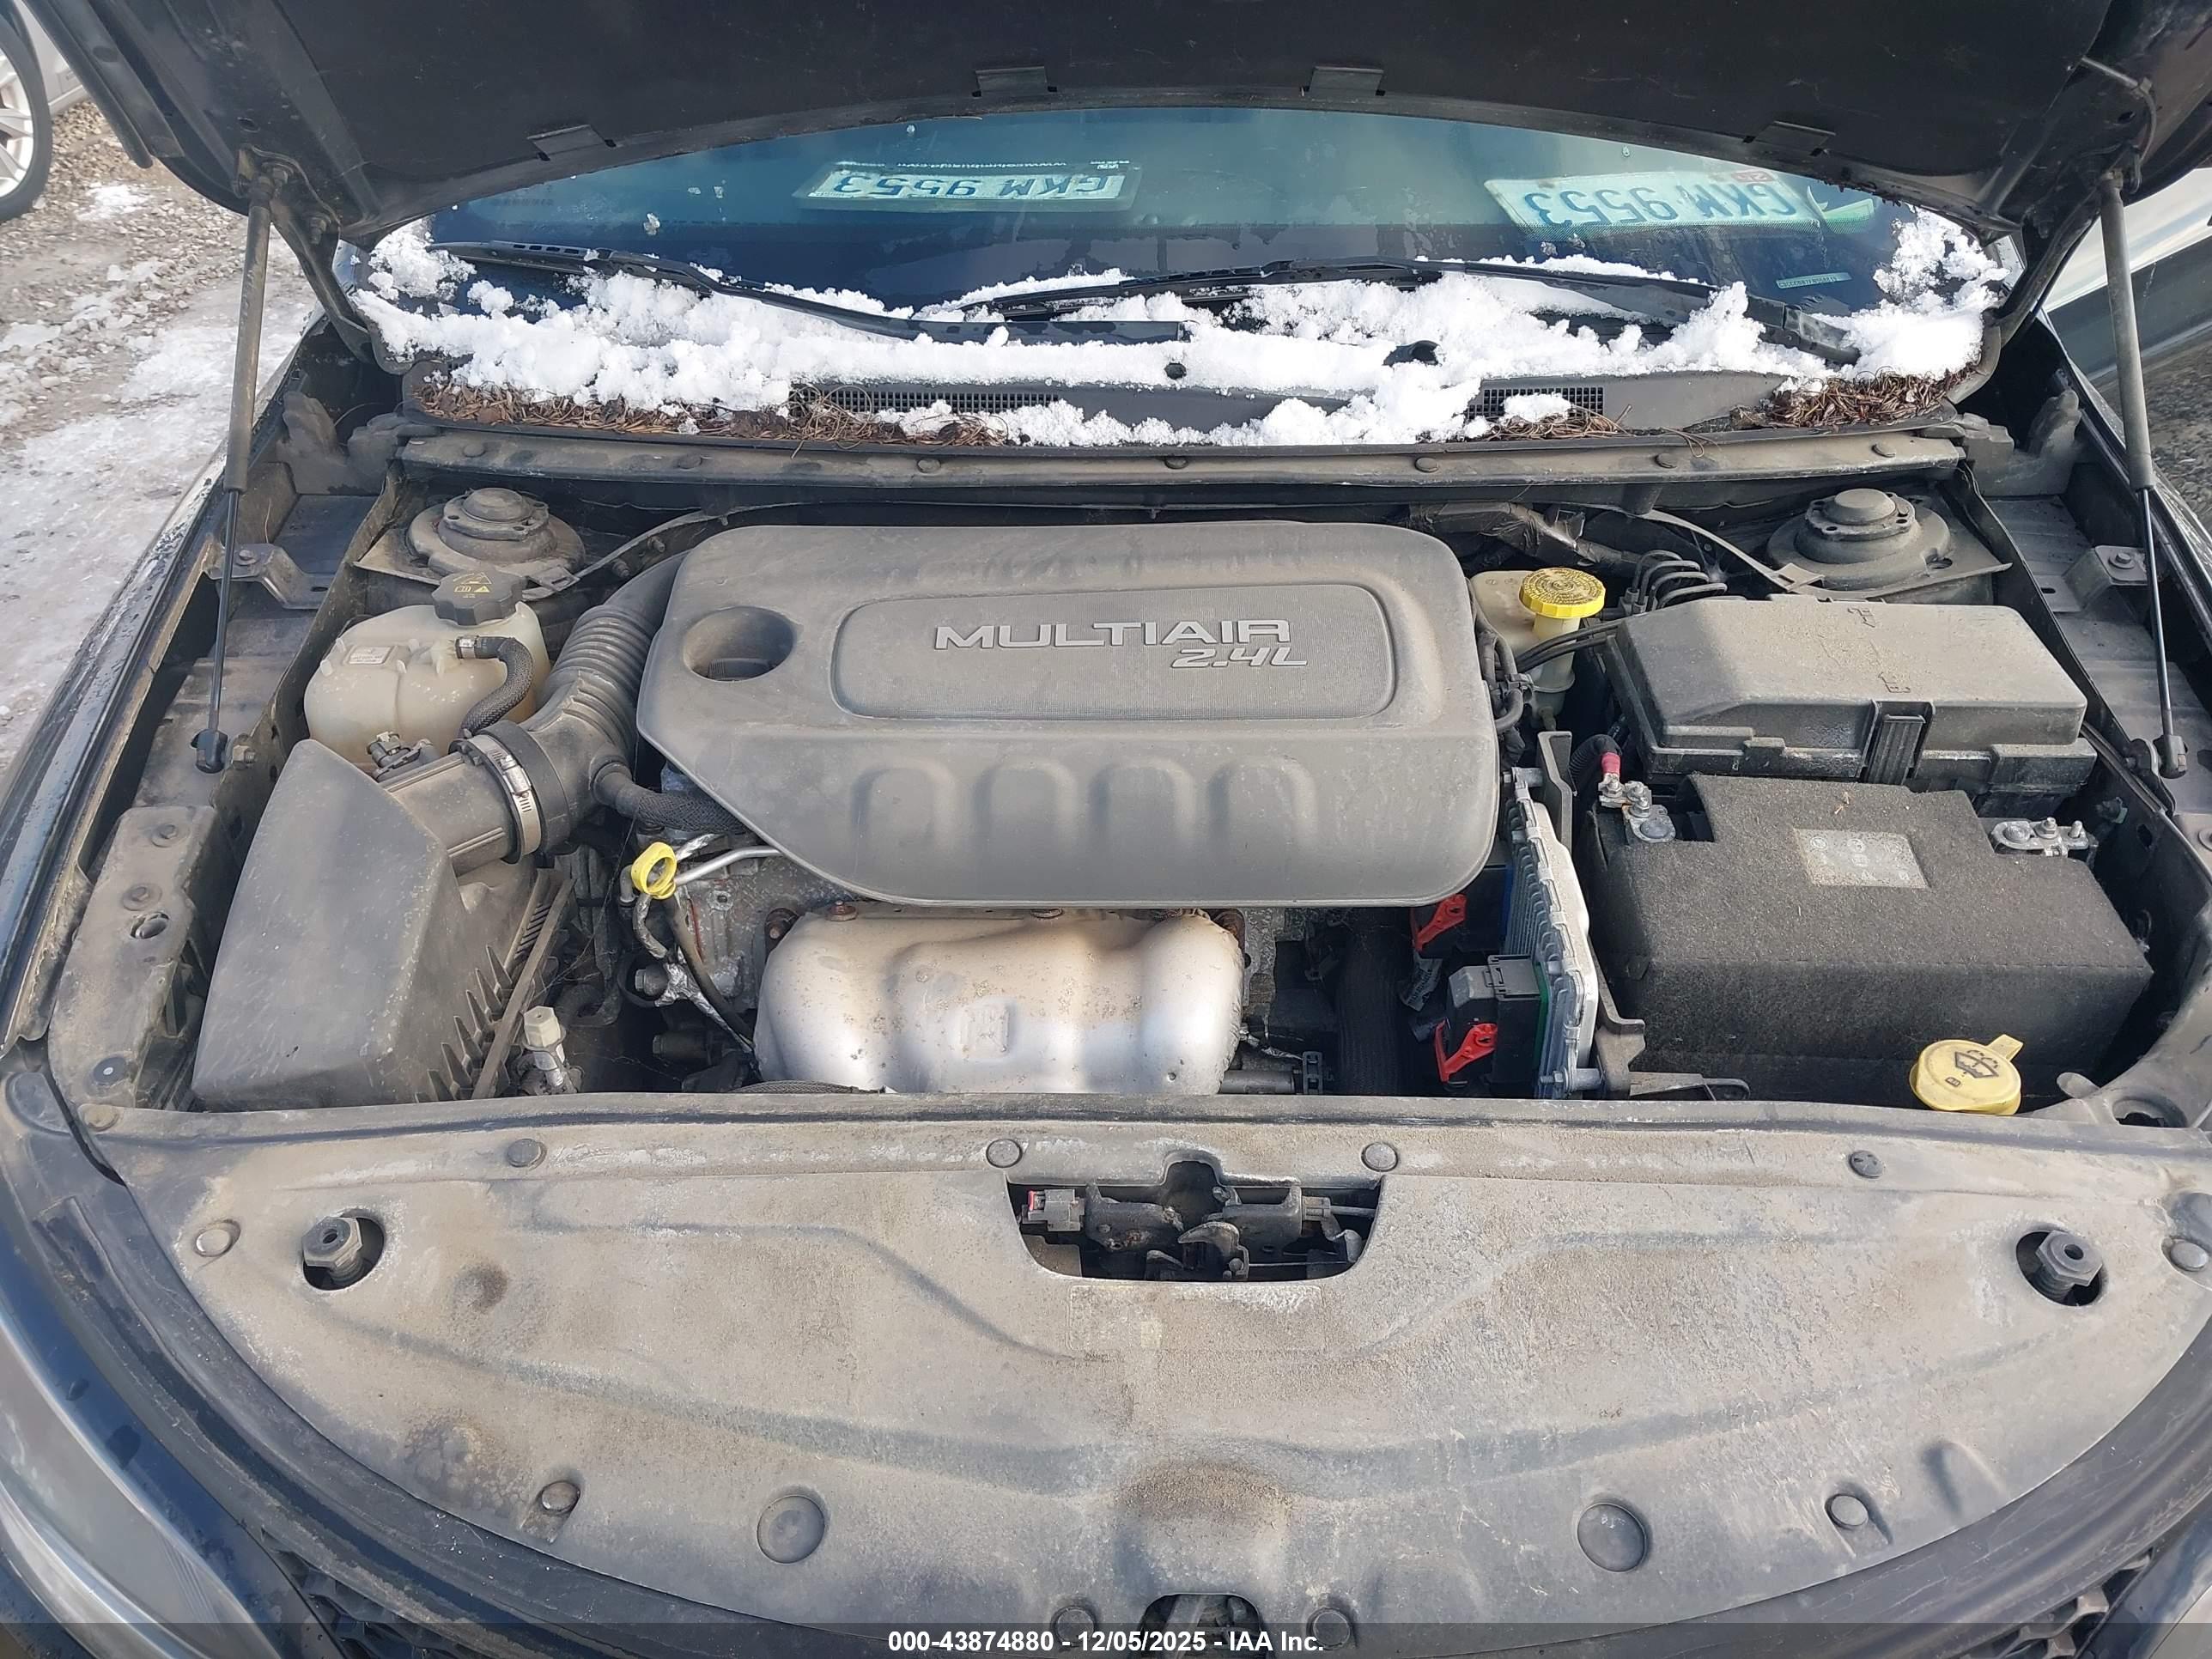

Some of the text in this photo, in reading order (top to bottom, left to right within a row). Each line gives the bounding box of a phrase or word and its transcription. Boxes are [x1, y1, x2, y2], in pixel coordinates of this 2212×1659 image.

[834, 175, 1106, 196] GKM 9553
[1524, 182, 1797, 226] GKM 9553
[935, 619, 1291, 650] MULTIAIR
[1170, 646, 1309, 669] 2.4L
